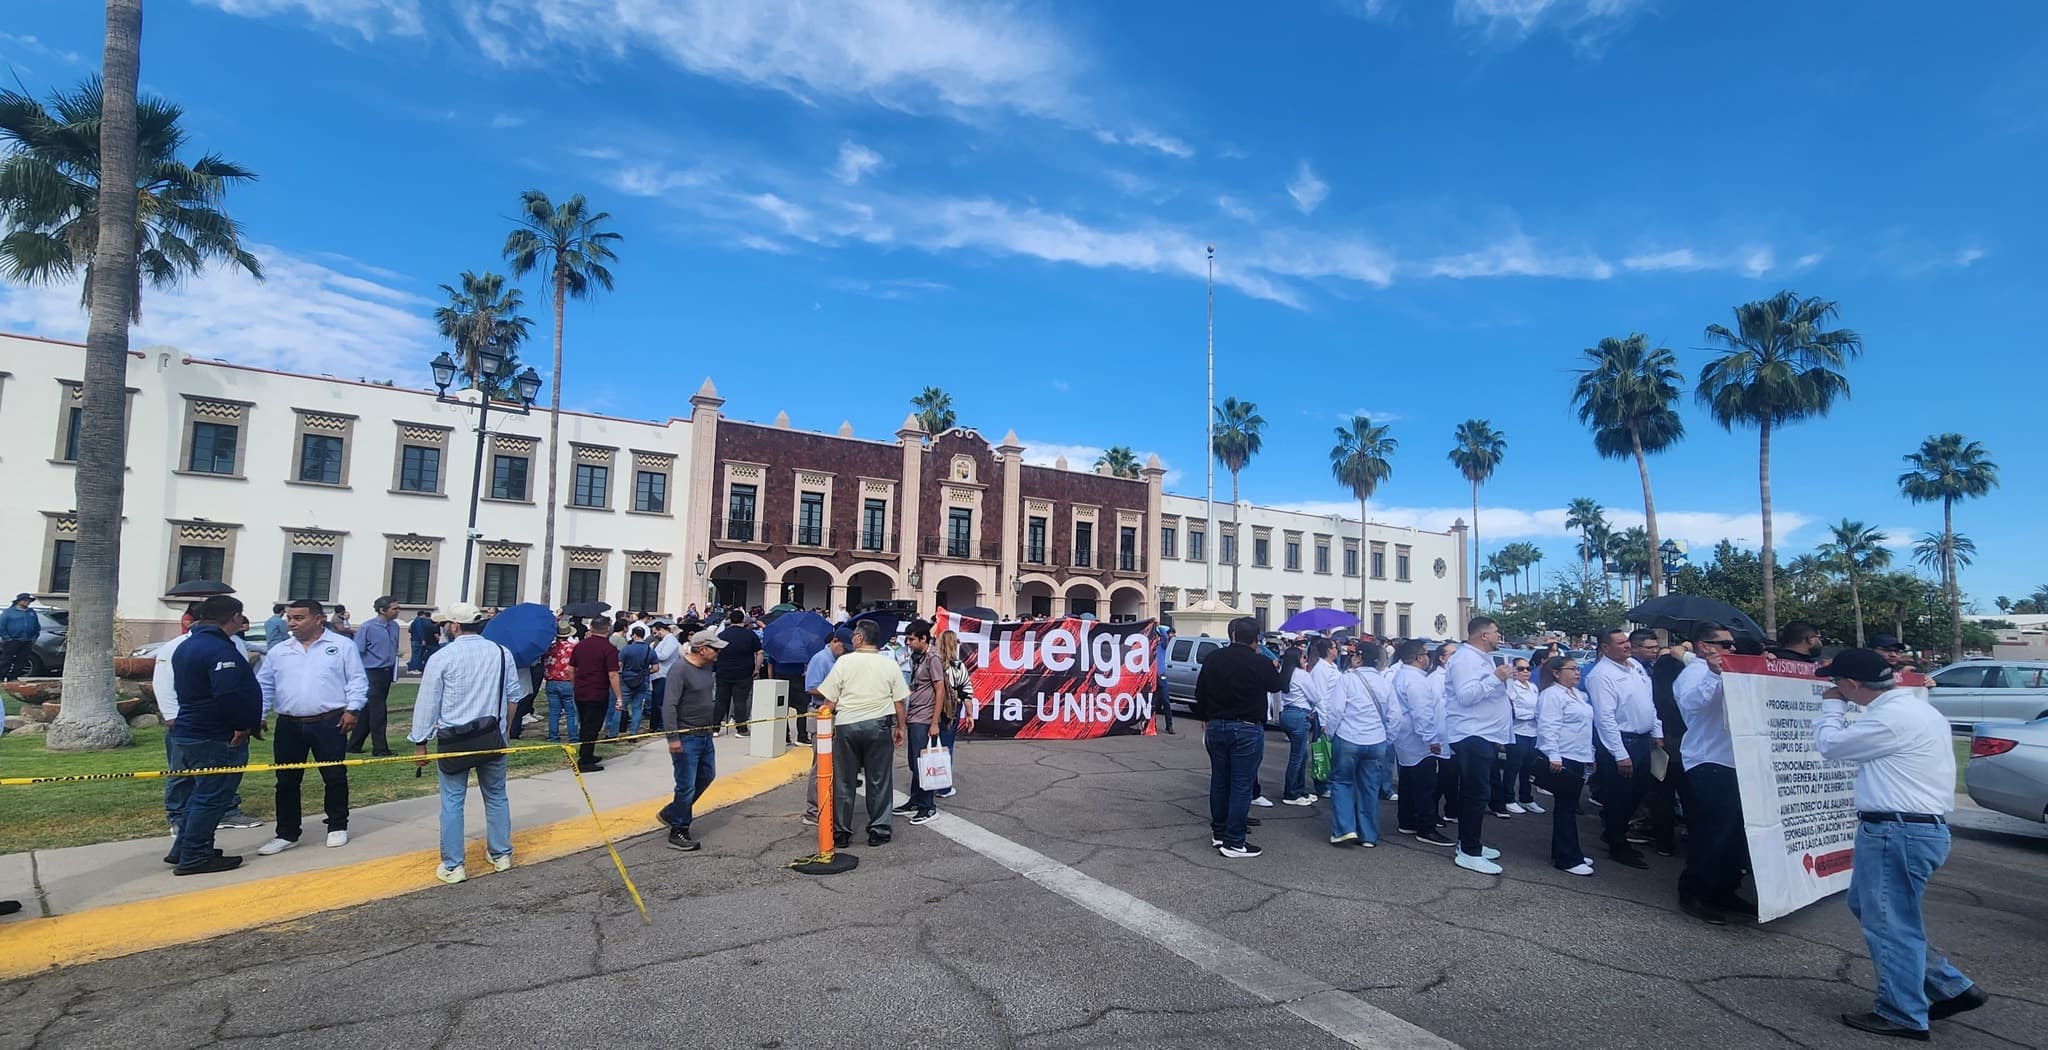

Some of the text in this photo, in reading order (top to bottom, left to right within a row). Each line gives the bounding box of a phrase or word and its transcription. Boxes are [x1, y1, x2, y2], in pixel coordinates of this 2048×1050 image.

[949, 612, 1149, 687] Huelga
[993, 691, 1023, 721] la
[1037, 692, 1153, 723] UNISON
[1795, 743, 1802, 752] DE
